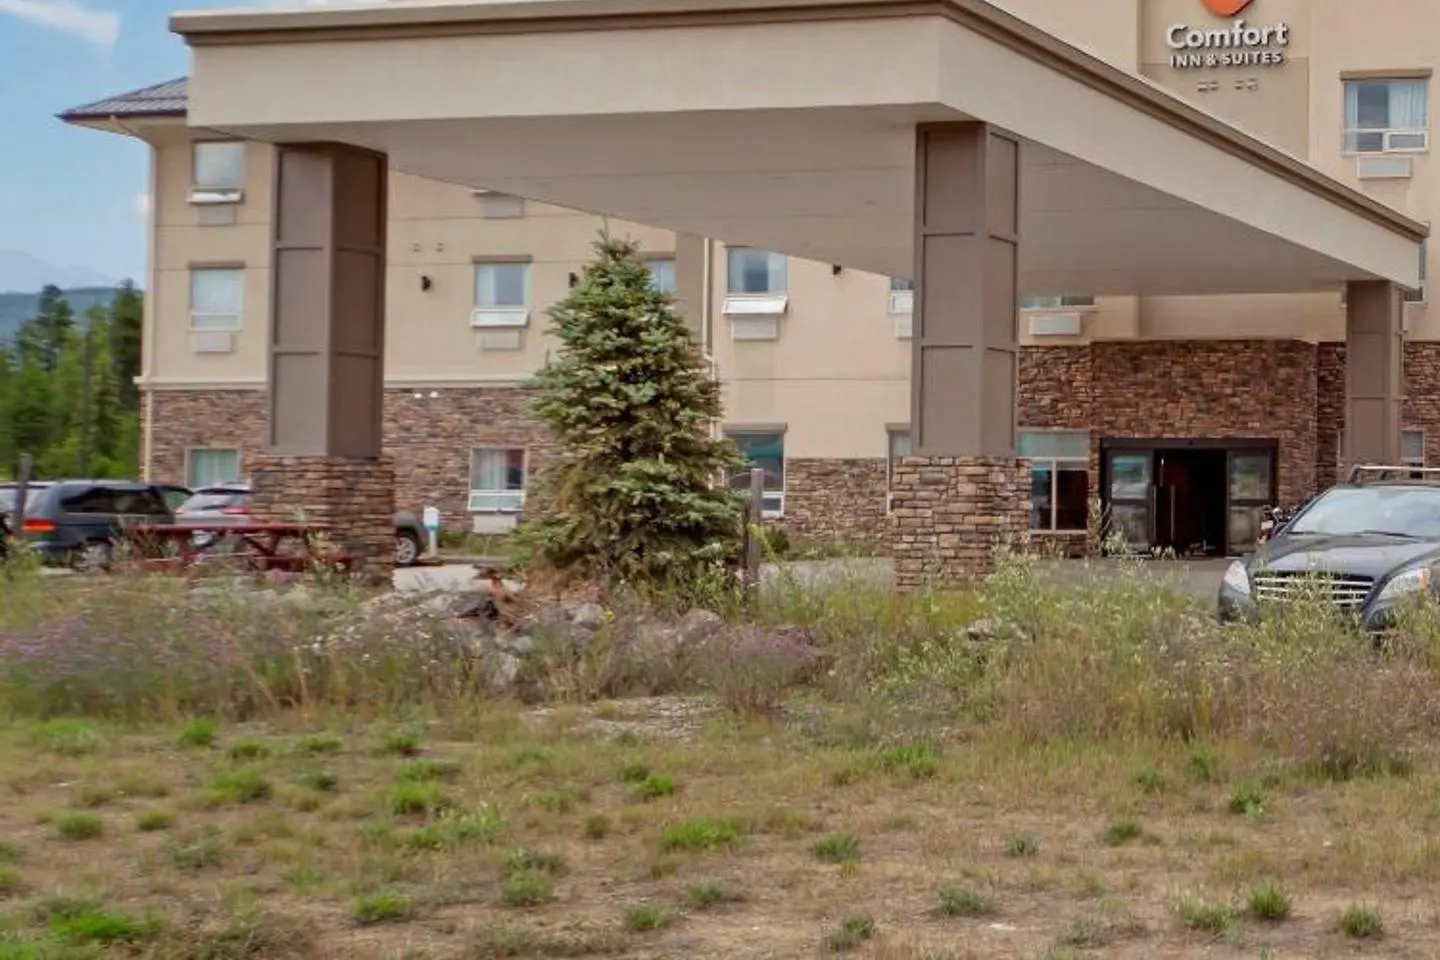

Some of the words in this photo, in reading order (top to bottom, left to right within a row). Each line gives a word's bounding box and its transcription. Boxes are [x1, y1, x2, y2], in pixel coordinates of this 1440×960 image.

[1166, 19, 1288, 49] Comfort
[1169, 54, 1202, 68] INN
[1206, 52, 1219, 67] &
[1222, 50, 1284, 66] SUITES
